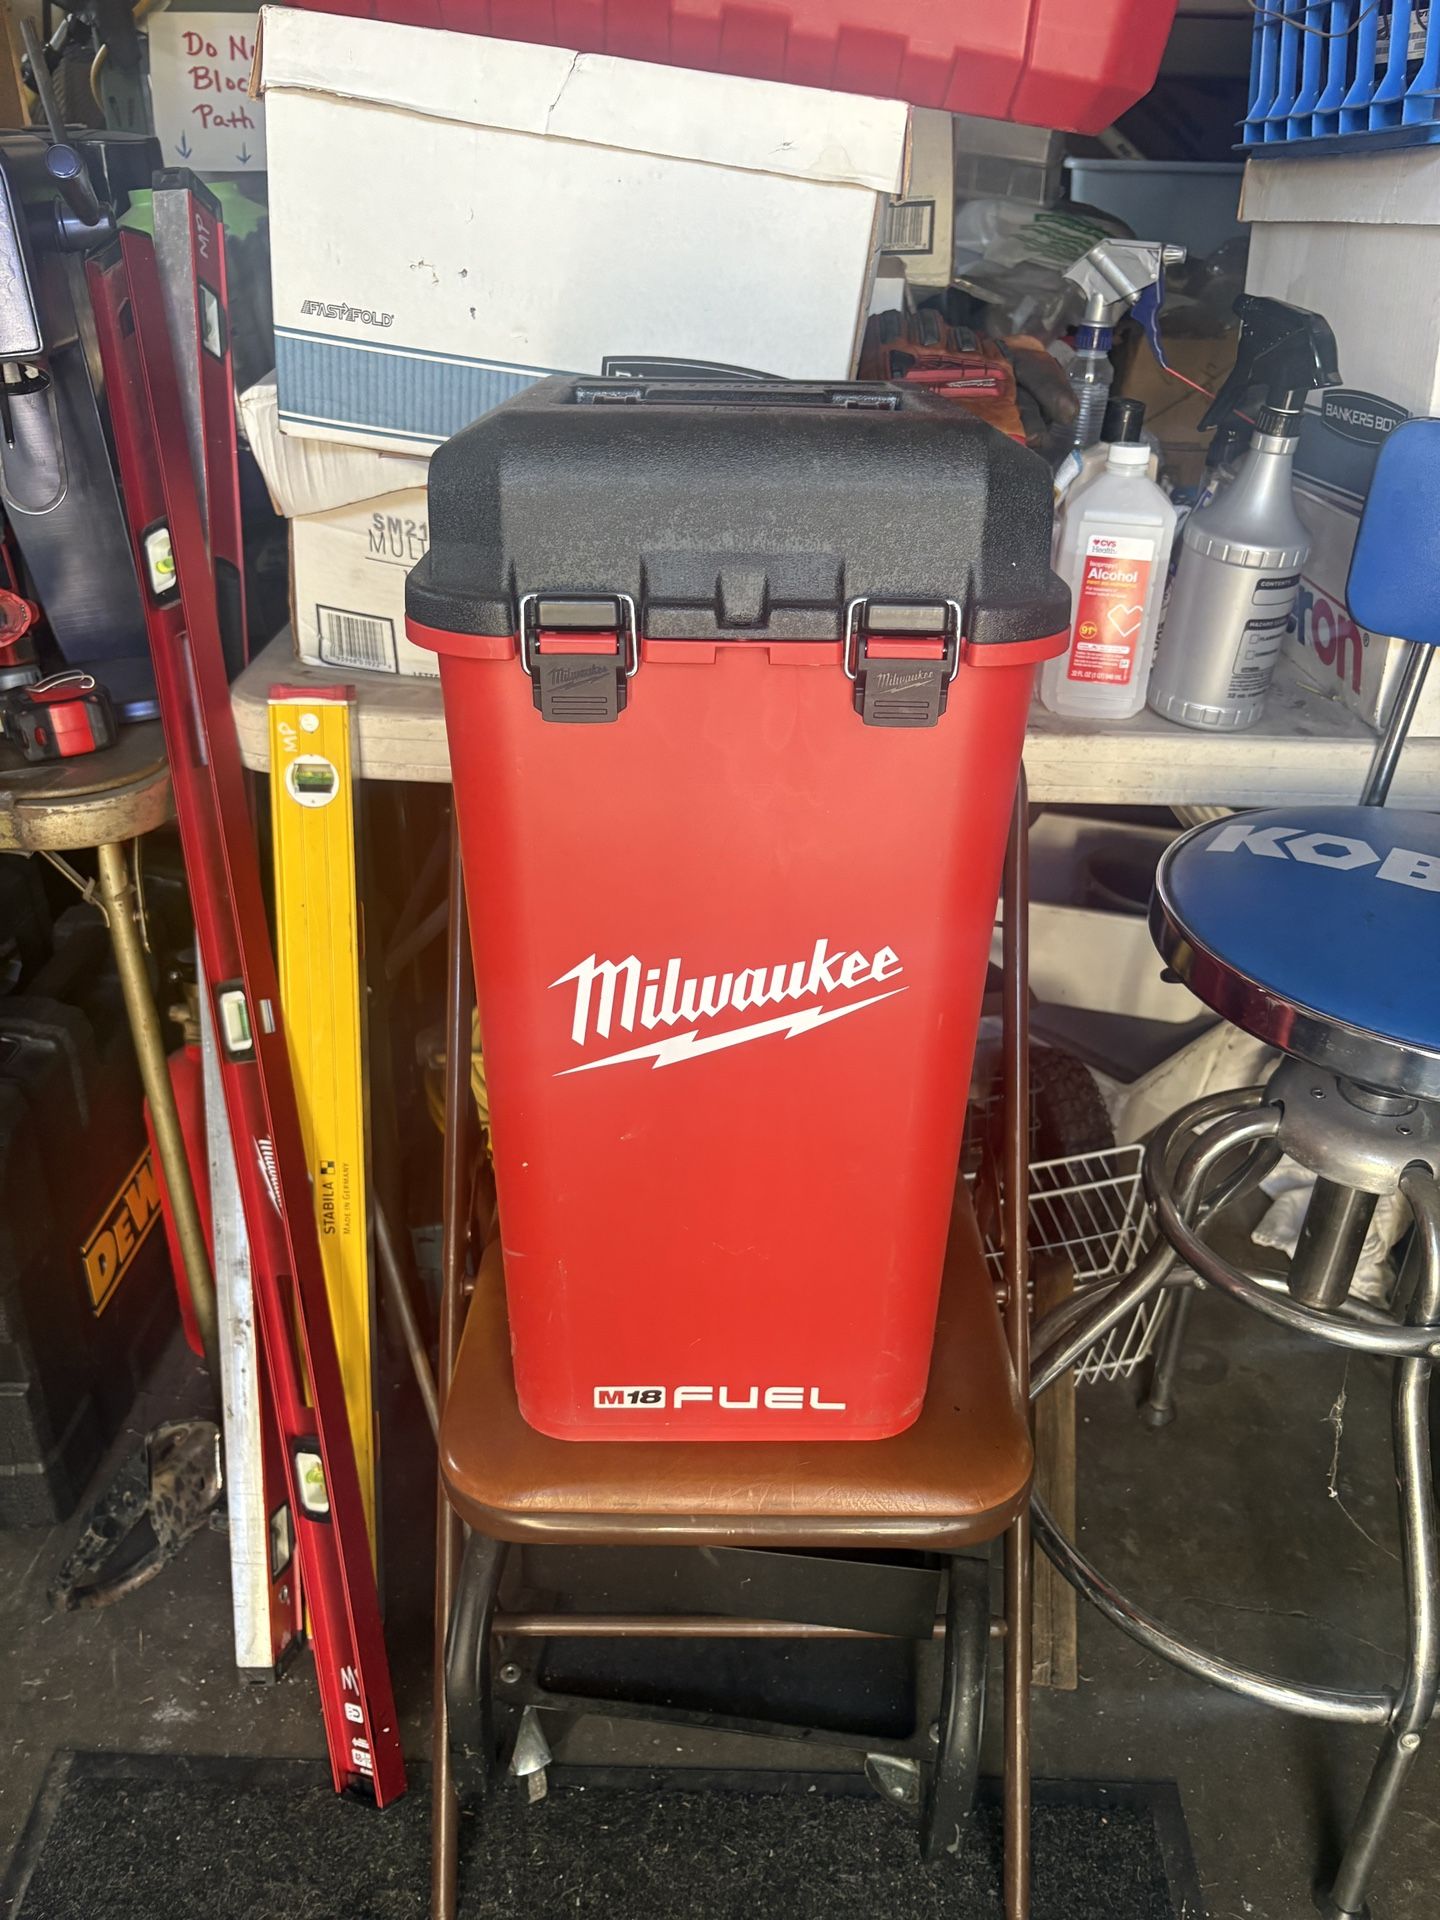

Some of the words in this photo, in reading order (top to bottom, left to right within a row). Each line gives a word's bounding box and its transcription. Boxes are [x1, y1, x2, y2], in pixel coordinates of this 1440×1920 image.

[182, 31, 218, 58] Do
[188, 66, 249, 93] Bloc
[192, 103, 255, 129] Path
[1325, 402, 1375, 428] BANKERS
[1092, 545, 1117, 555] Health
[1100, 539, 1117, 547] CVS
[1088, 567, 1138, 583] Alcohol
[877, 669, 935, 688] Milwaukee
[278, 721, 298, 752] MP
[547, 938, 903, 1047] Milwaukee
[322, 1181, 336, 1234] STABILA
[597, 1389, 664, 1406] M18
[674, 1385, 847, 1410] FUEL
[341, 1665, 360, 1696] M
